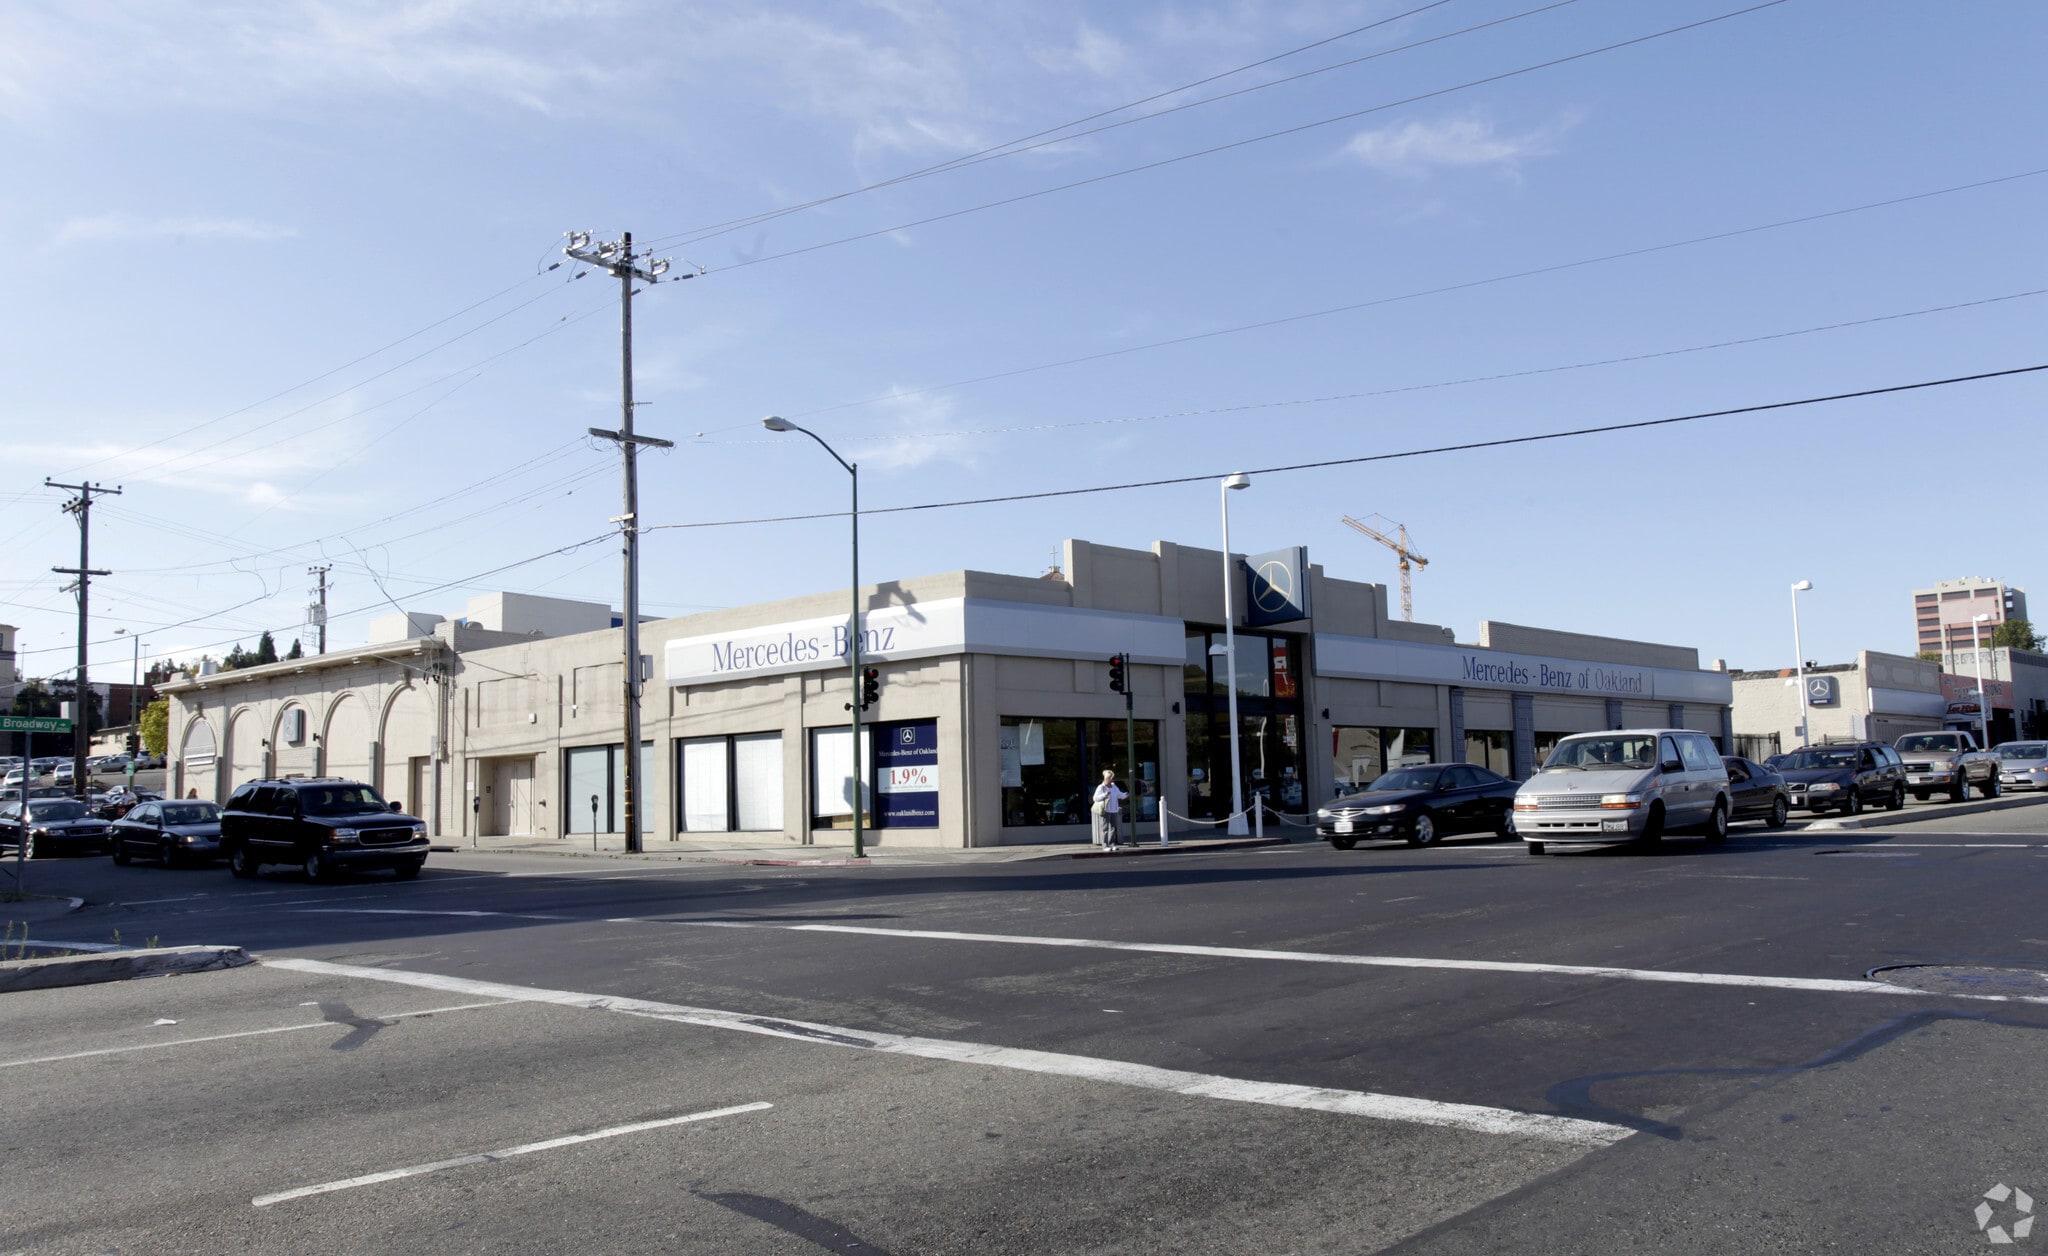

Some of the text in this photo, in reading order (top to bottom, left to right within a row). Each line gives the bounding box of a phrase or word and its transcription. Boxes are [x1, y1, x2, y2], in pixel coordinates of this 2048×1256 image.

[1578, 668, 1590, 689] of
[1595, 668, 1642, 693] Oakland
[3, 718, 57, 731] Broadway
[890, 767, 927, 785] 1.9%
